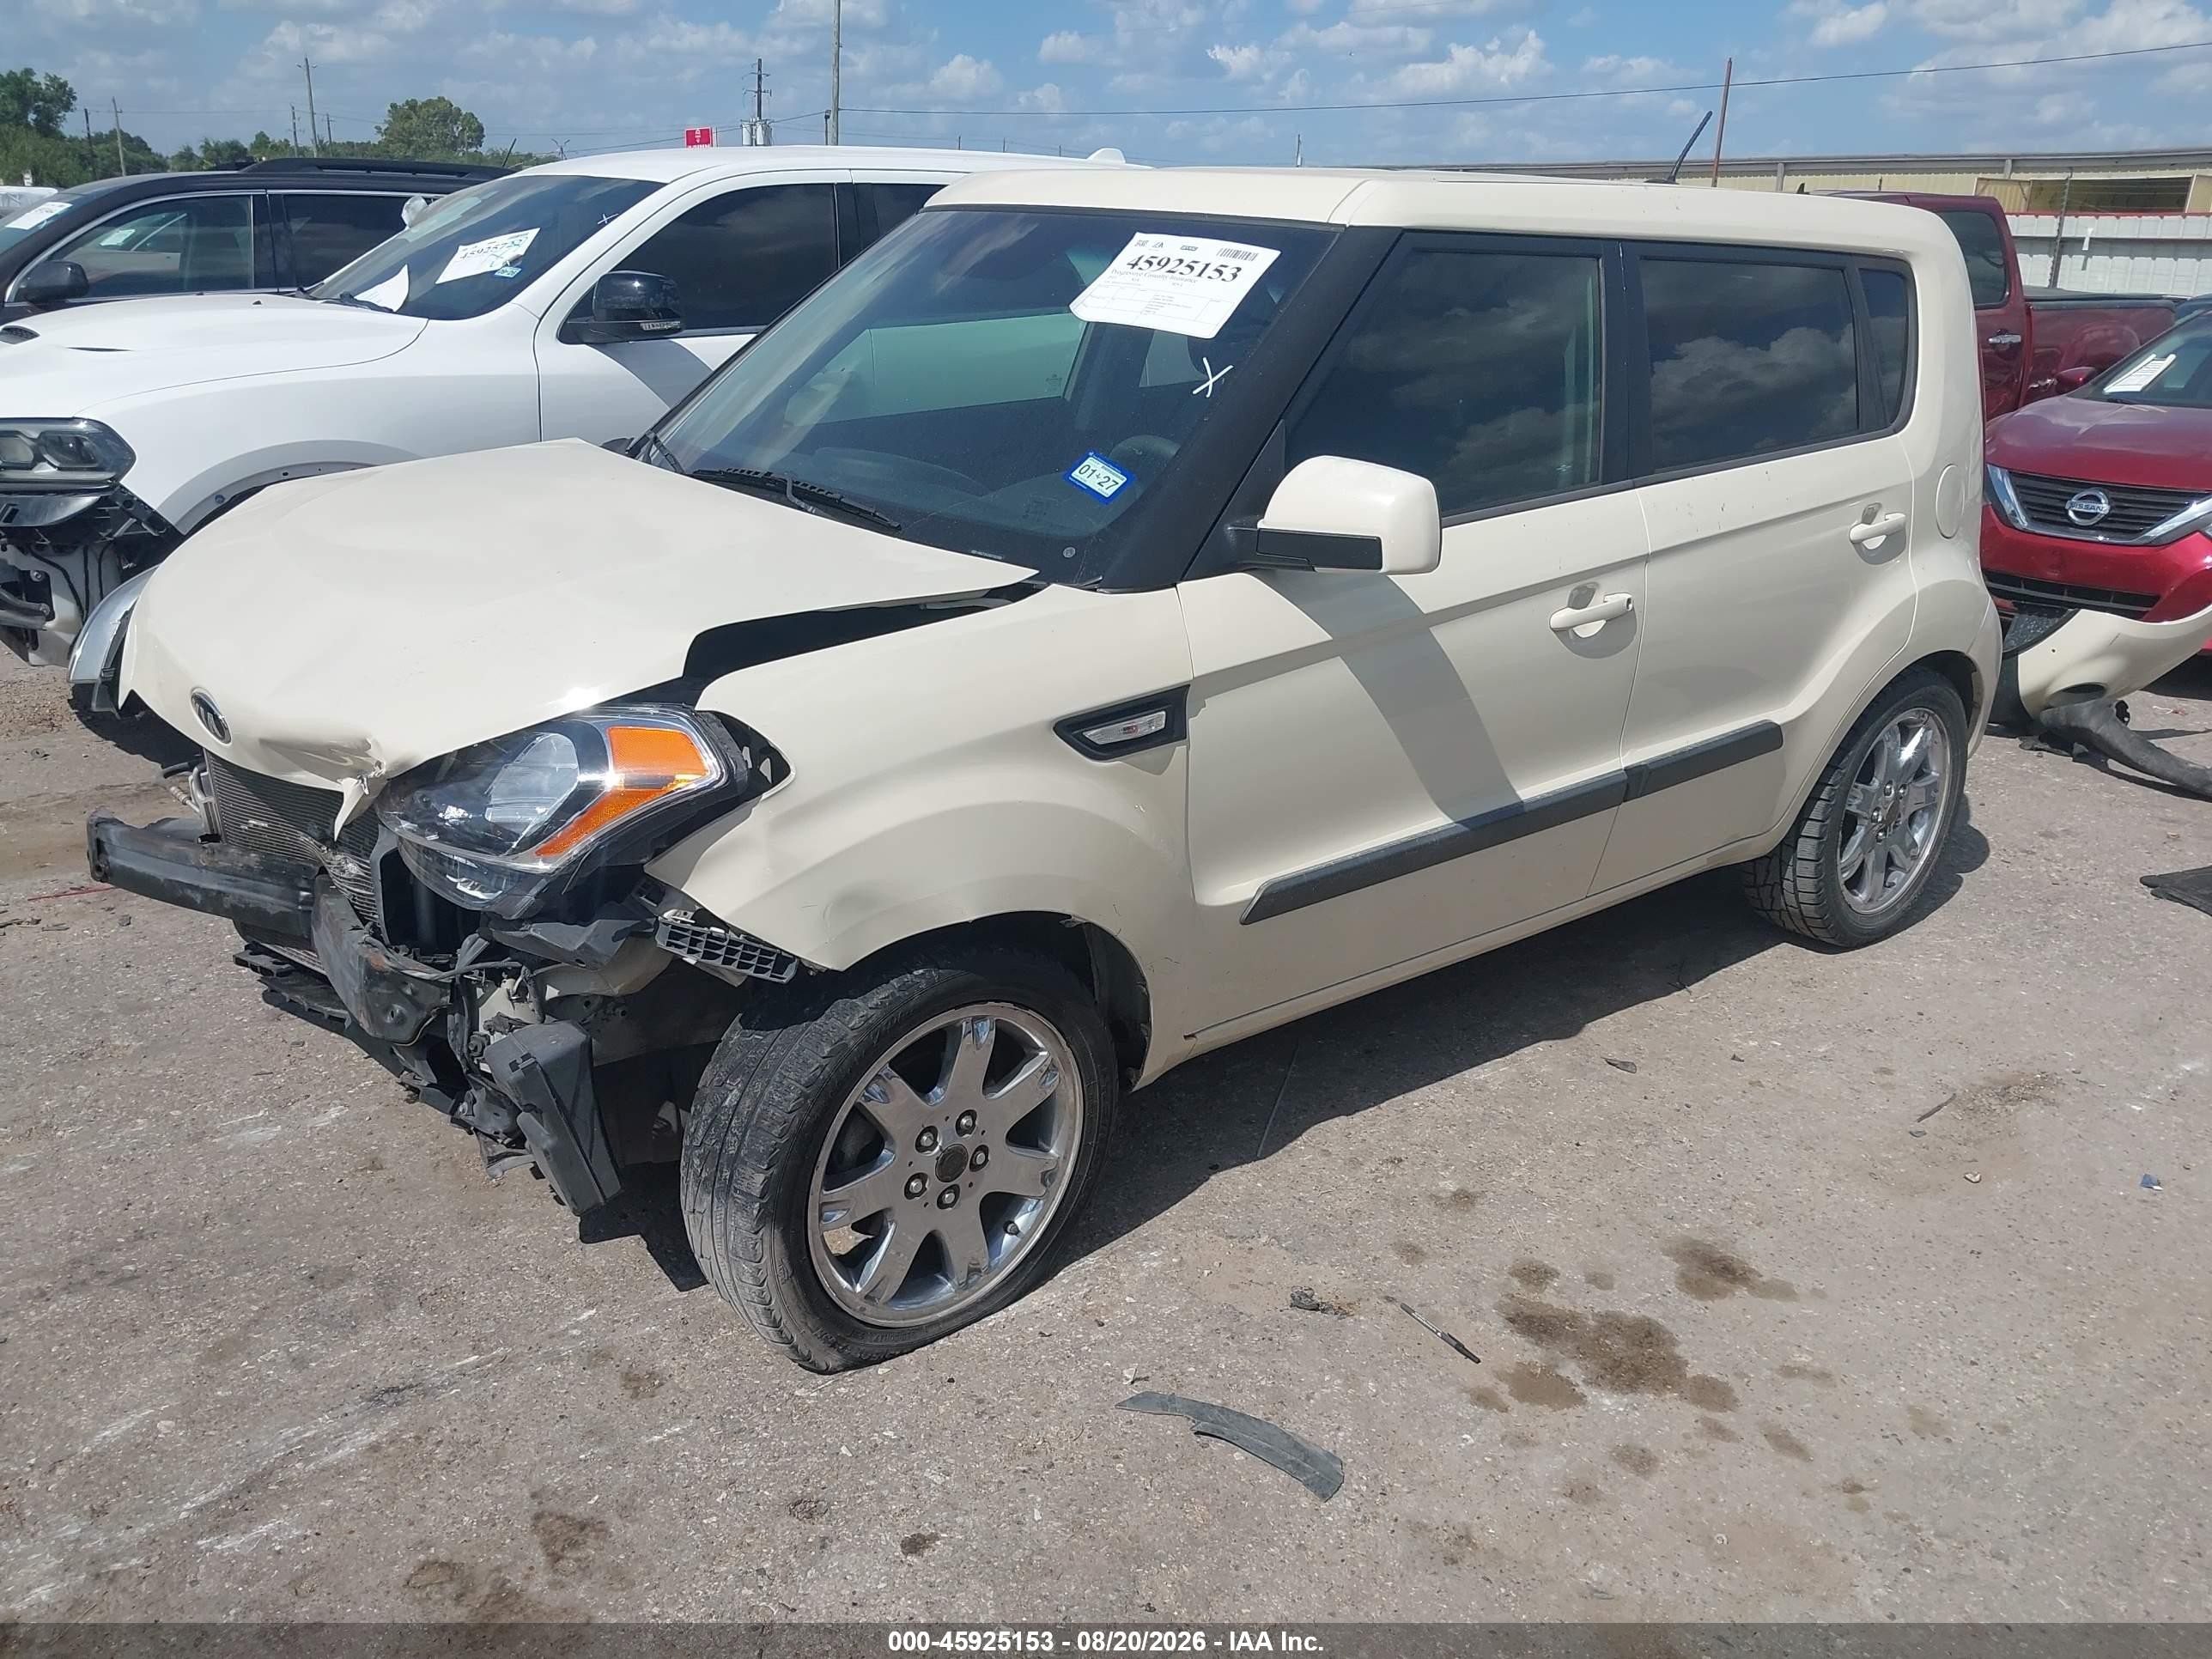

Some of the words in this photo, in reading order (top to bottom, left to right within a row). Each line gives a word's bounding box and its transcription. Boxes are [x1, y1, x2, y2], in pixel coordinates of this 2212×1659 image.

[1127, 254, 1243, 283] 45925153
[1079, 464, 1096, 479] 01
[1097, 476, 1120, 490] 27
[2069, 501, 2104, 512] NISSAN
